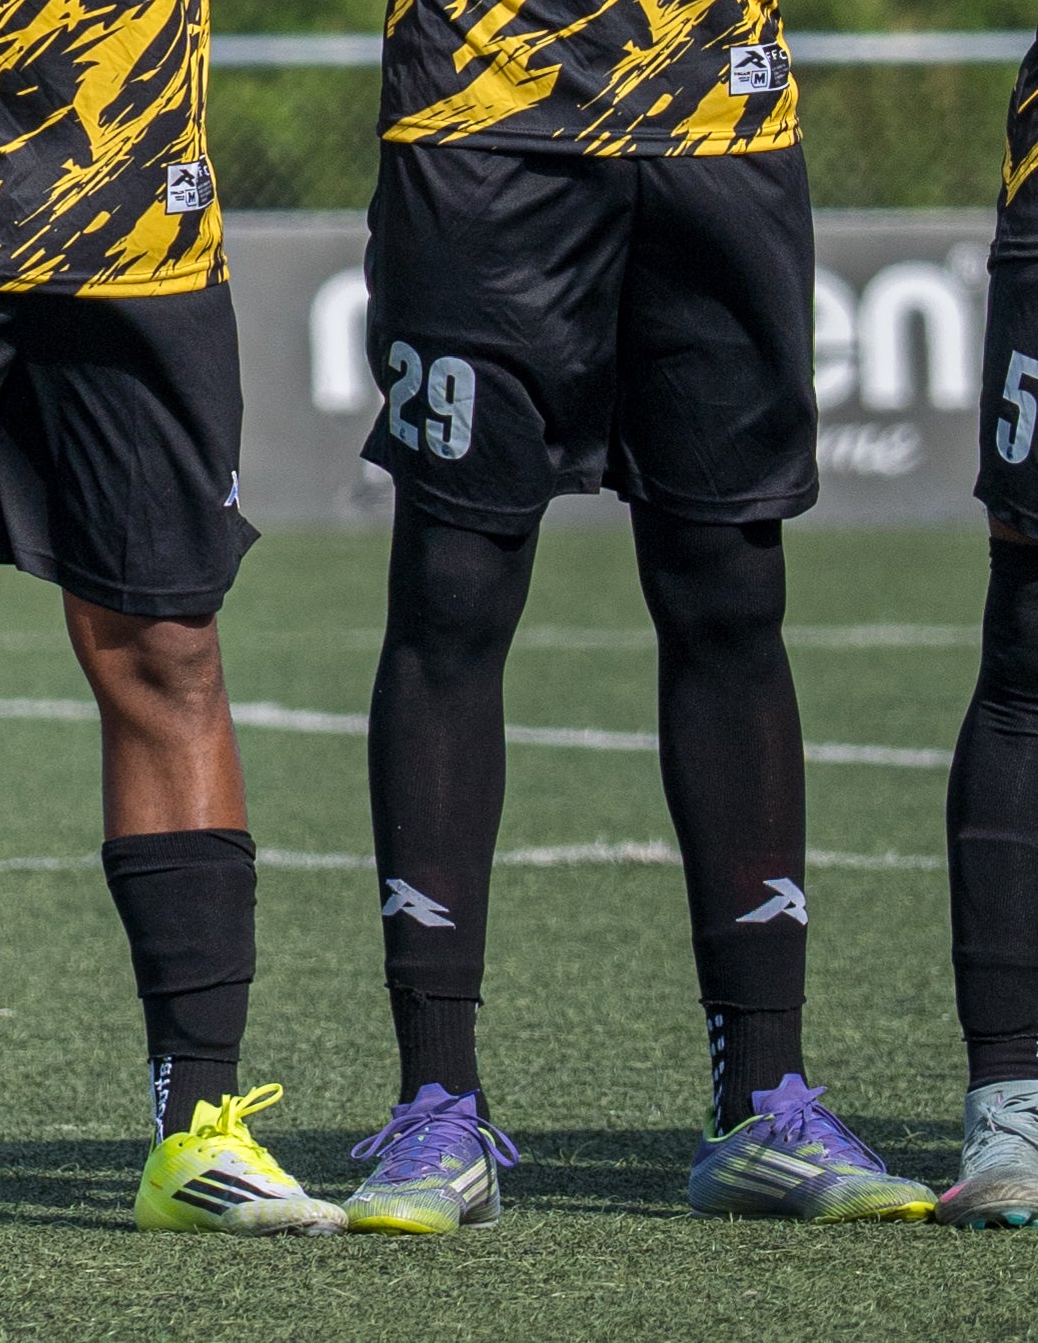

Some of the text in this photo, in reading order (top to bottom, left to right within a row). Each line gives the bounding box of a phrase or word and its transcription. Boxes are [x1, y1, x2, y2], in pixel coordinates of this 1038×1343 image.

[754, 73, 766, 84] M
[387, 341, 476, 460] 29
[996, 349, 1038, 464] 5
